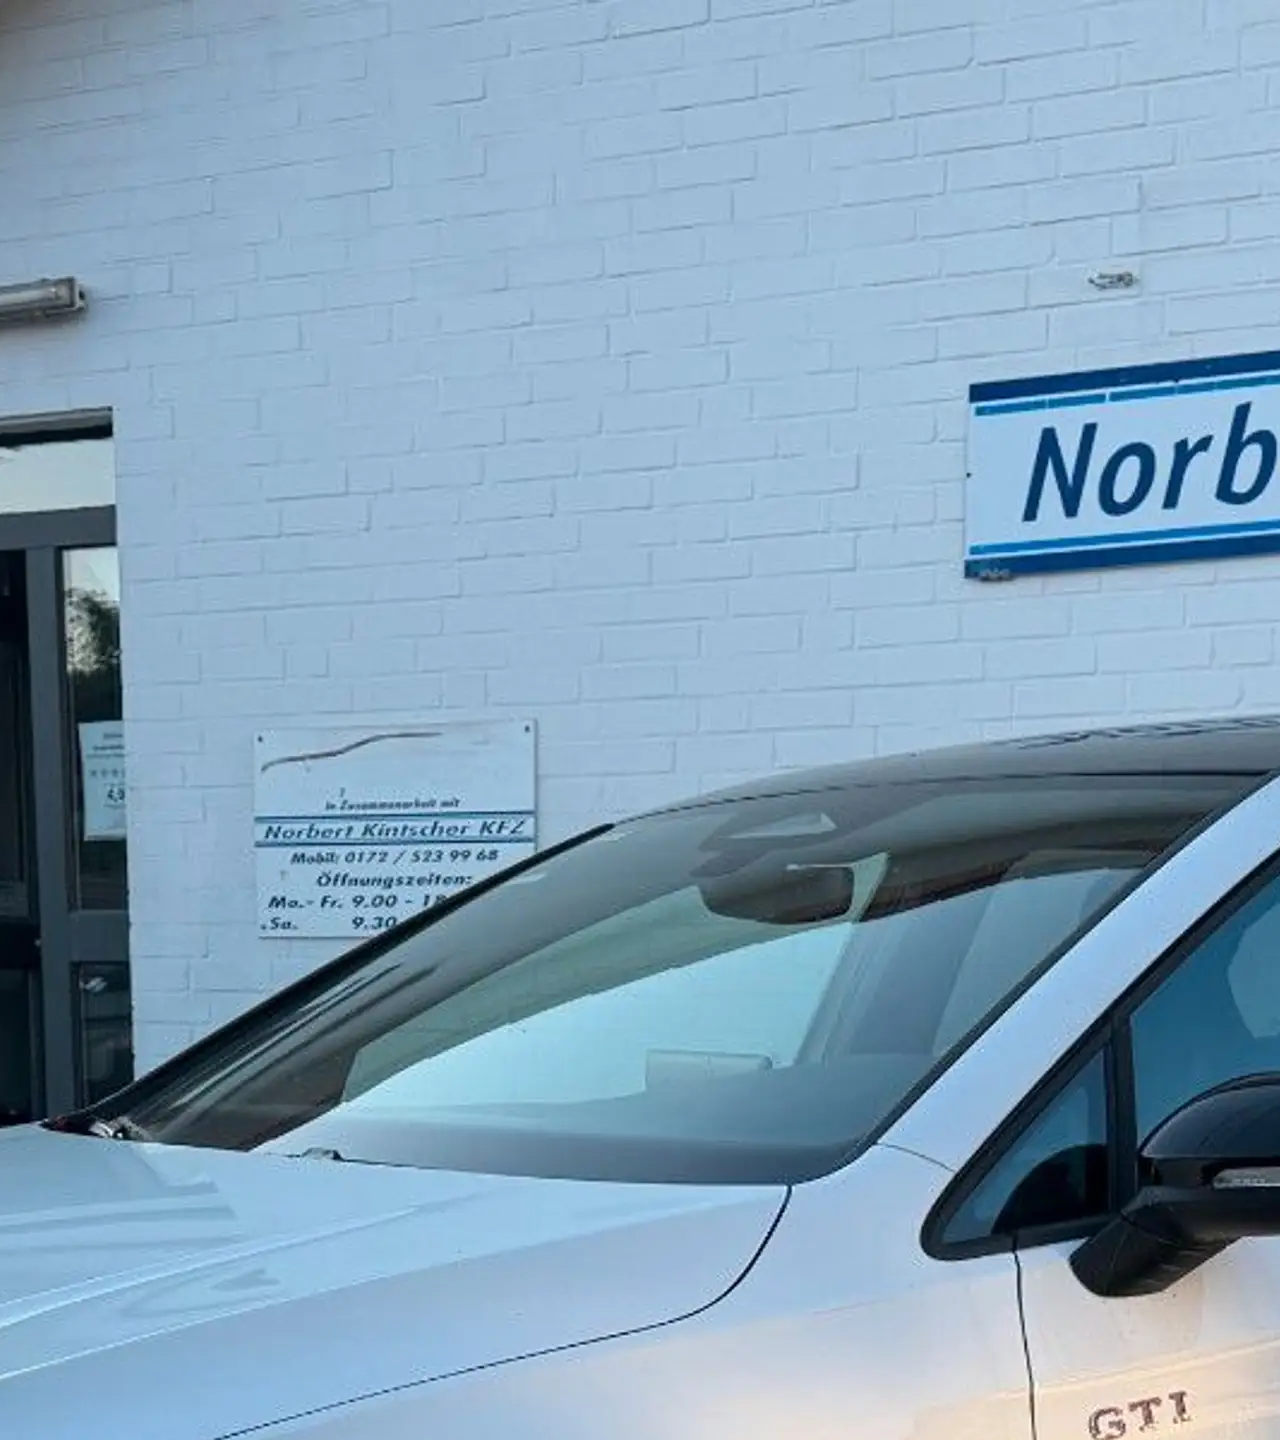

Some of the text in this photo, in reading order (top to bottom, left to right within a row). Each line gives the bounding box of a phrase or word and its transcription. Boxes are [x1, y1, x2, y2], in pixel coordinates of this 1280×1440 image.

[264, 818, 526, 840] Norbert Kintscher KFZ
[290, 851, 340, 865] Mobil:
[344, 850, 389, 864] 0172
[410, 849, 444, 863] 523
[450, 848, 471, 861] 99
[317, 870, 472, 889] Öffnungszeiten:
[320, 894, 344, 909] Fr.
[352, 894, 398, 908] 9.00
[352, 916, 397, 931] 9.30
